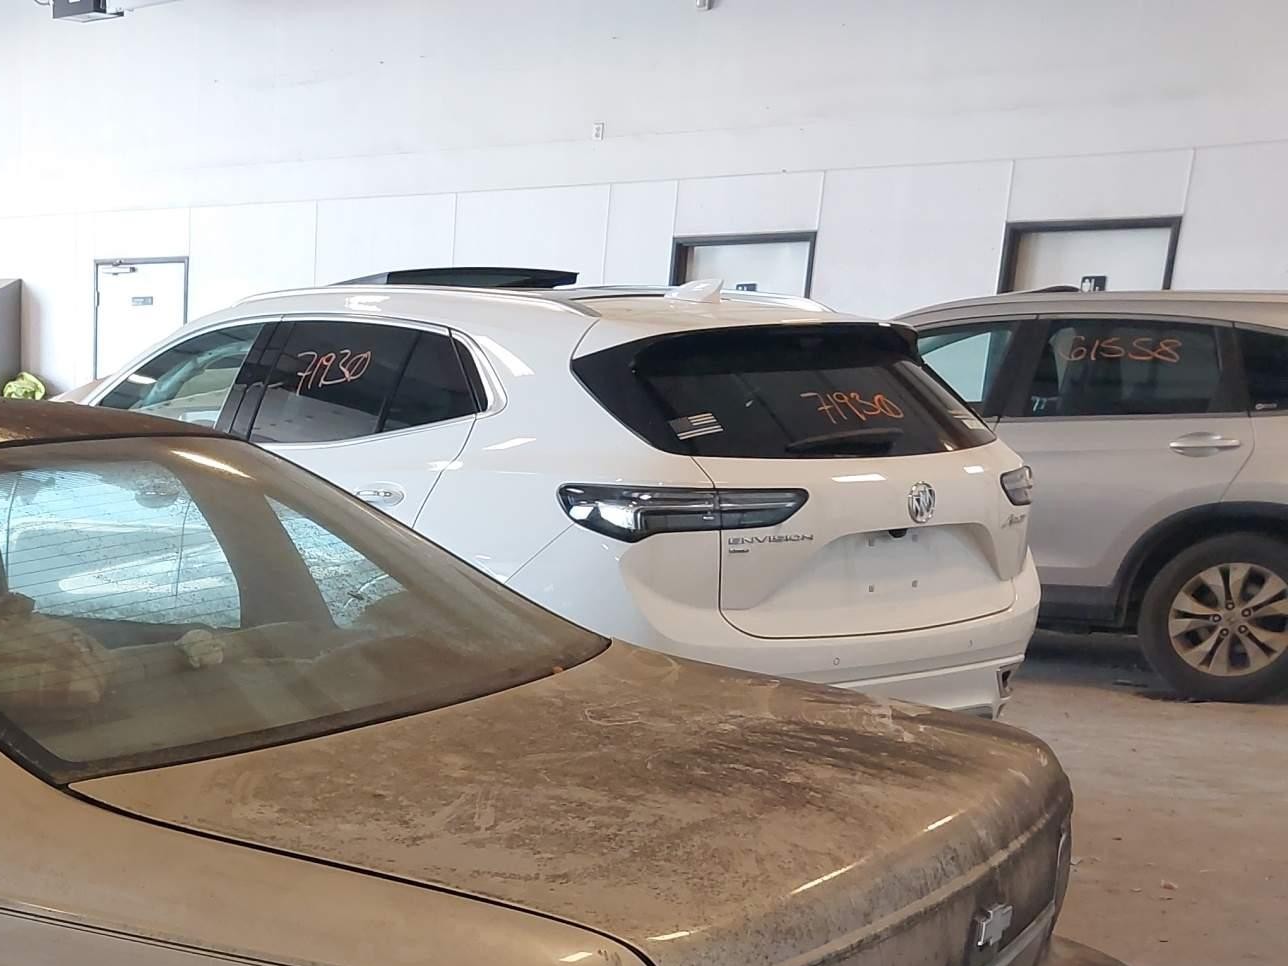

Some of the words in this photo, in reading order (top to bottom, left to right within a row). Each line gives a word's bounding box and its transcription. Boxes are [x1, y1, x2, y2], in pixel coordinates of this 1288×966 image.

[1062, 334, 1183, 364] 61558
[296, 349, 372, 397] 71930
[799, 391, 905, 425] 71930
[728, 533, 814, 546] ENVISION
